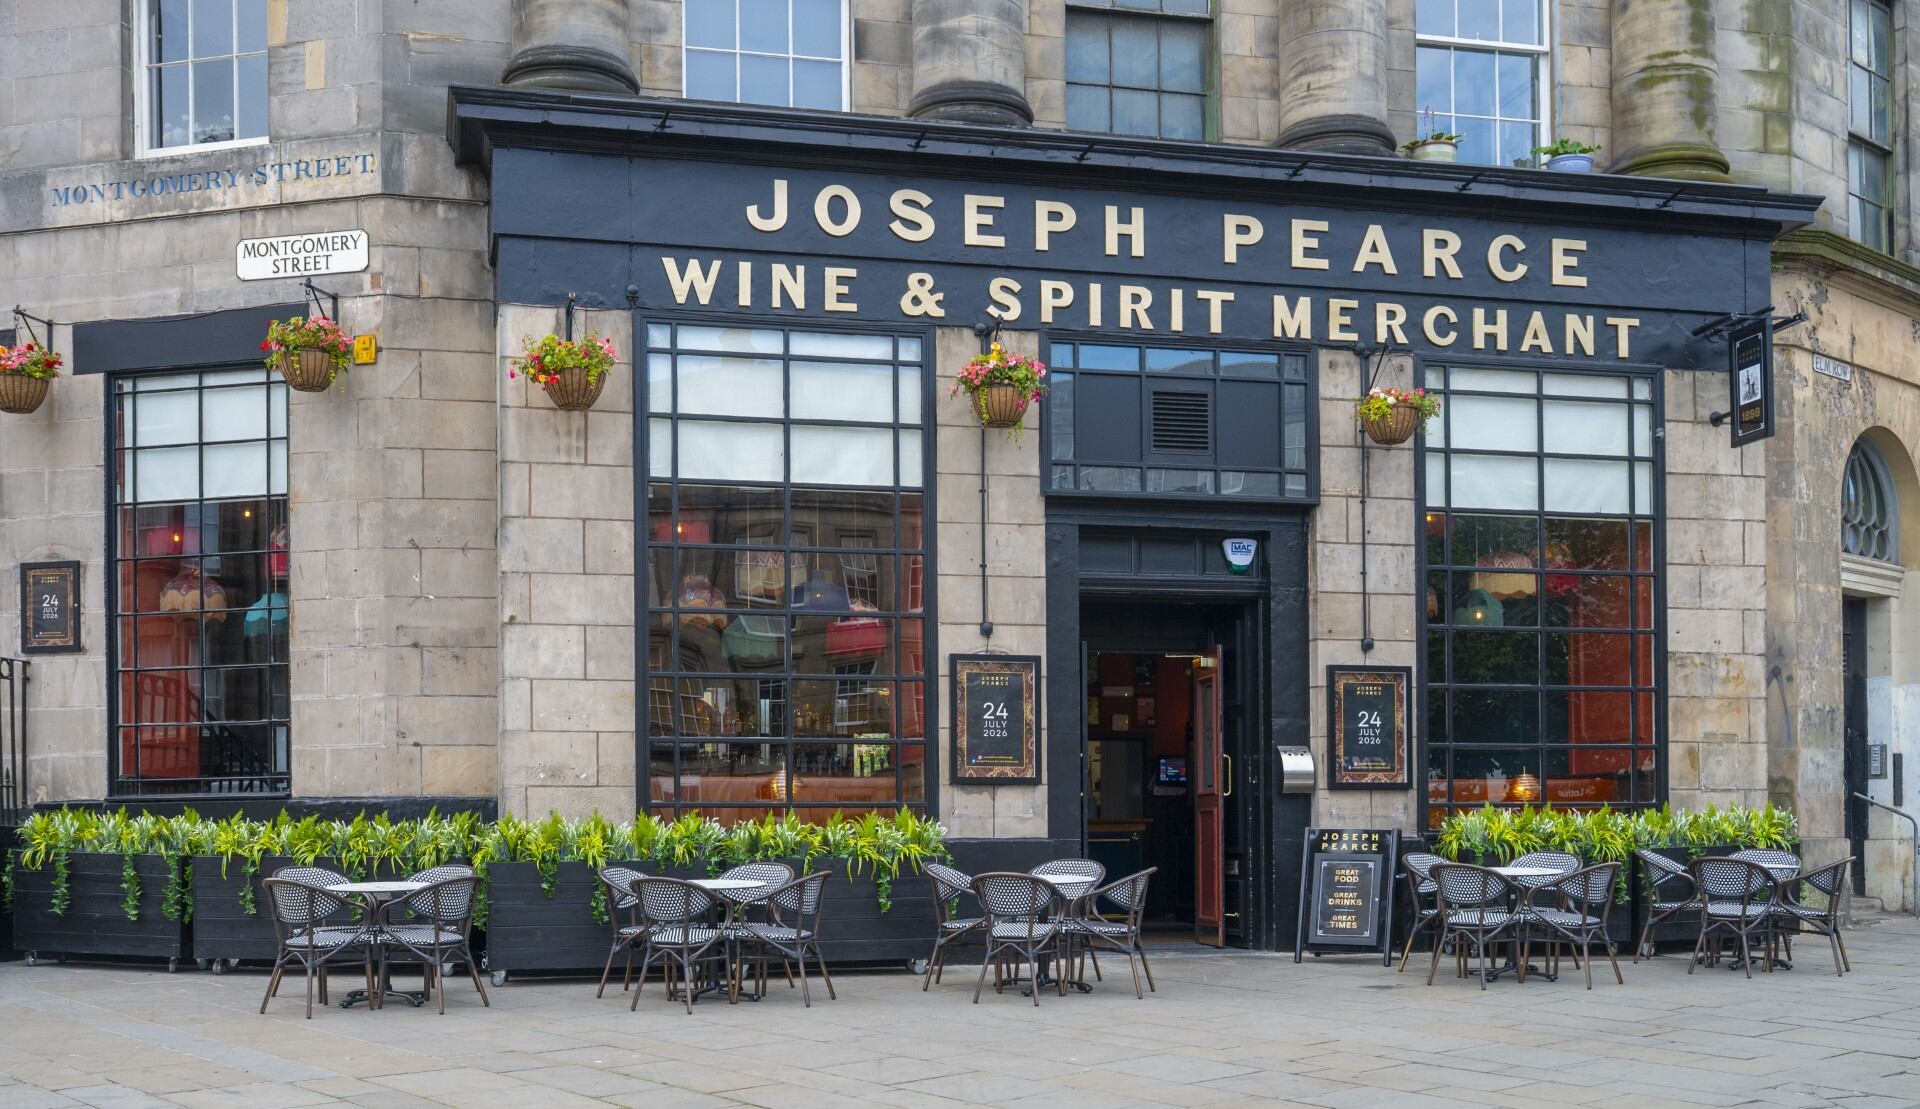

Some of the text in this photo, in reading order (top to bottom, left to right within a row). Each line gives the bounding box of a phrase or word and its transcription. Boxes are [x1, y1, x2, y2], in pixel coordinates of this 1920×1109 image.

[52, 168, 241, 207] MONTGOMERY
[746, 179, 1588, 288] JOSEPH PEARCE
[242, 233, 361, 259] MONTGOMERY
[272, 254, 333, 274] STREET
[661, 257, 1640, 359] WINE & SPIRIT MERCHANT
[1815, 356, 1849, 378] ELM ROW
[1741, 406, 1760, 422] 1898
[42, 594, 59, 607] 24
[983, 702, 1009, 720] 24
[983, 720, 1008, 728] JULY
[1357, 711, 1382, 728] 24
[983, 729, 1008, 737] 2026
[1358, 728, 1381, 736] JULY
[1322, 833, 1379, 841] JOSEPH
[1321, 843, 1379, 851] PEARCE
[1329, 921, 1358, 929] TIMES
